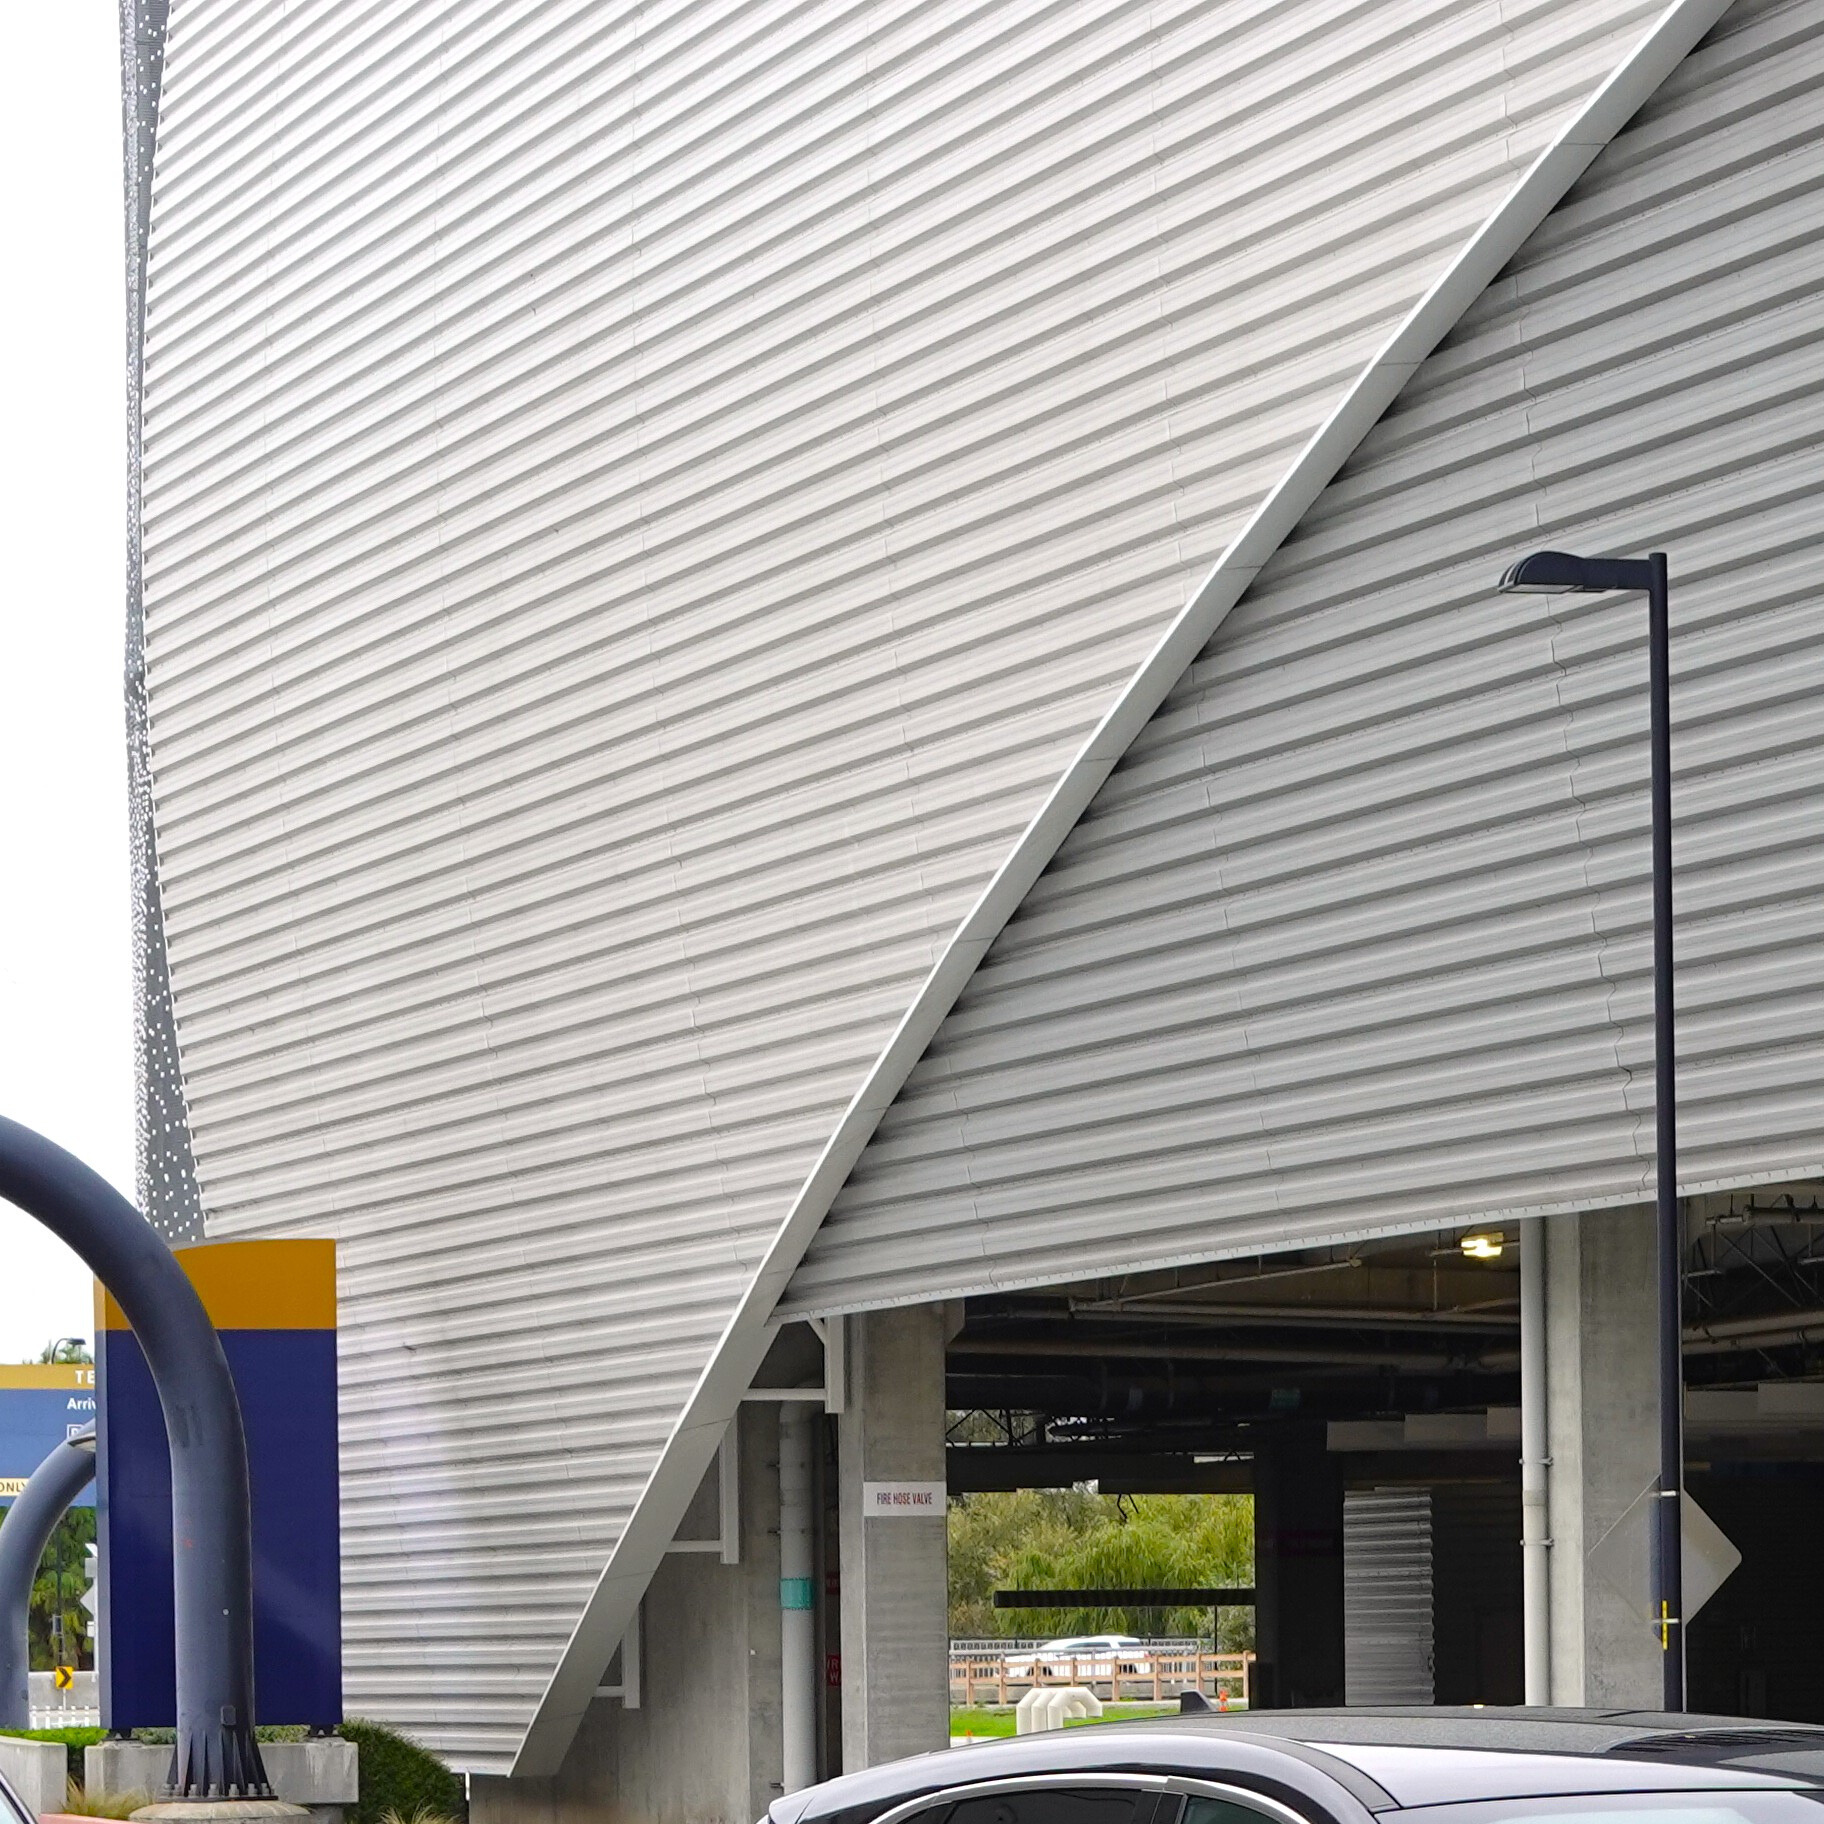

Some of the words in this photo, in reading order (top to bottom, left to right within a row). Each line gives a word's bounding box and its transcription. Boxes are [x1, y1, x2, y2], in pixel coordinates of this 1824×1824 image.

[877, 1492, 891, 1504] FIRE
[893, 1492, 910, 1504] HOSE
[912, 1492, 932, 1504] VALVE
